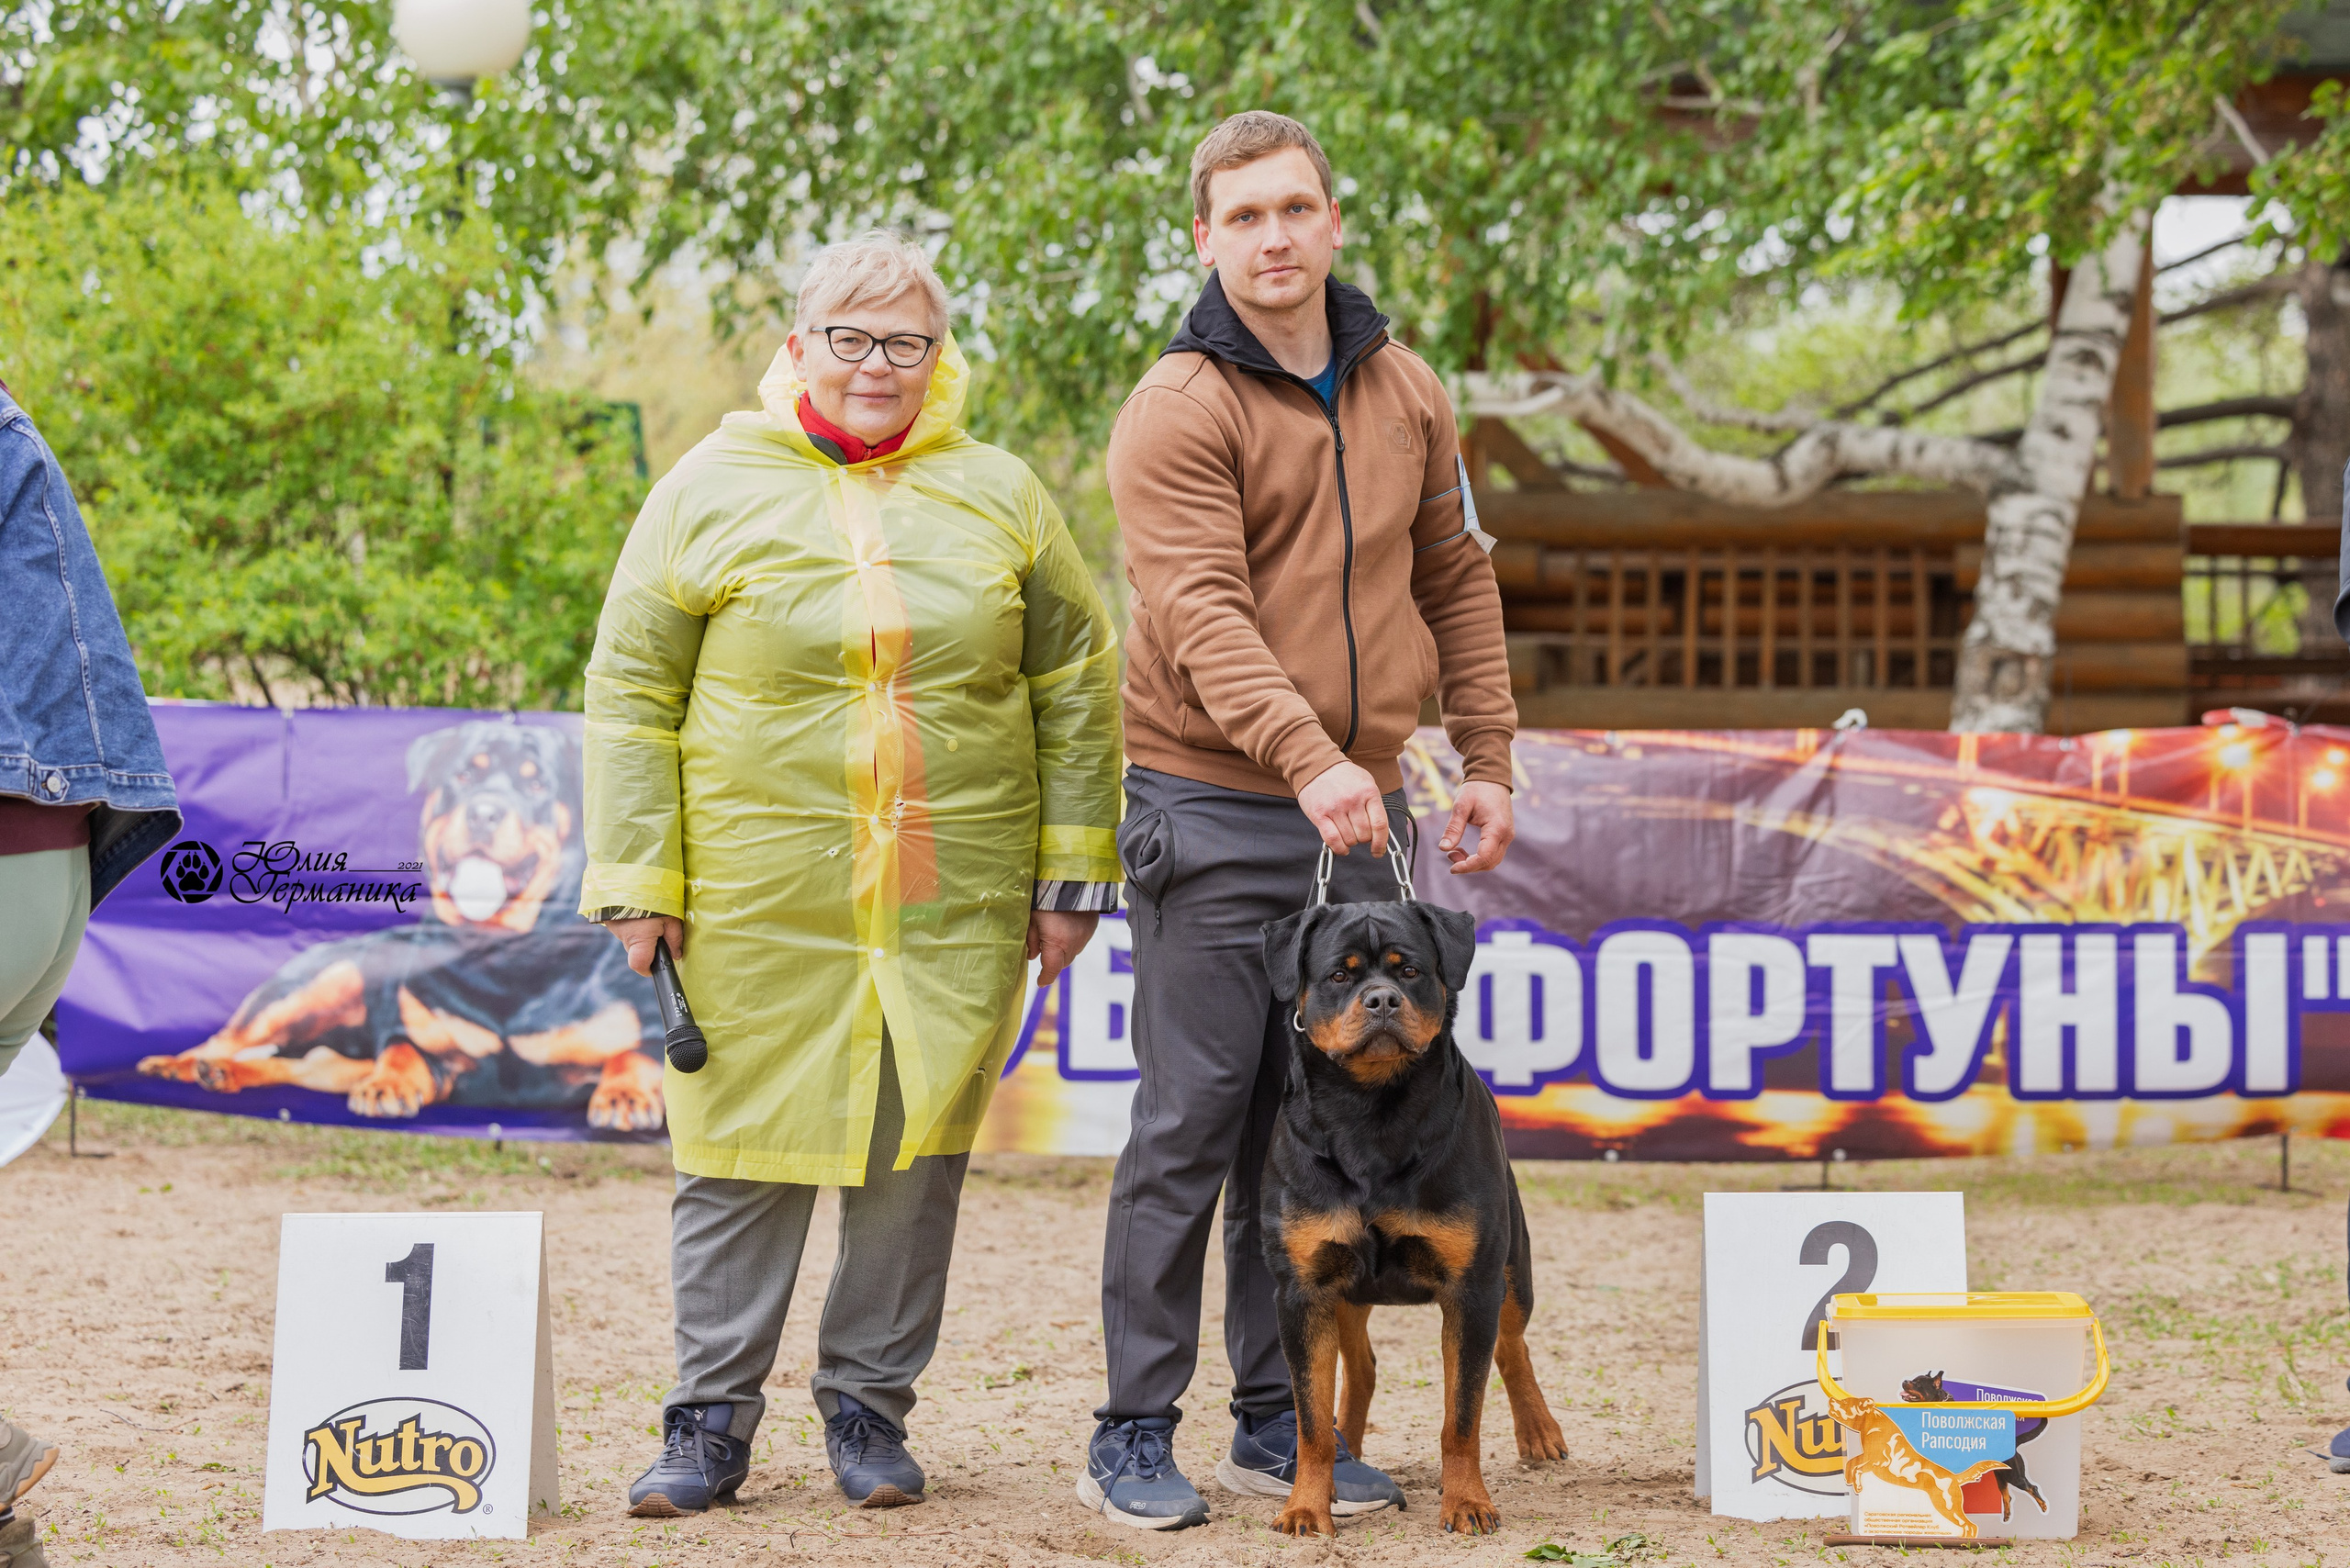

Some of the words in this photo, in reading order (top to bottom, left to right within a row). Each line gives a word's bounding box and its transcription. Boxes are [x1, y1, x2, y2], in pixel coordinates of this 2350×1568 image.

[384, 1242, 435, 1371] 1
[1798, 1220, 1878, 1351] 2
[1921, 1411, 2006, 1430] Поволжская
[1921, 1431, 1987, 1452] Рапсодия
[305, 1414, 487, 1513] Nutro
[1128, 1501, 1147, 1510] FILA
